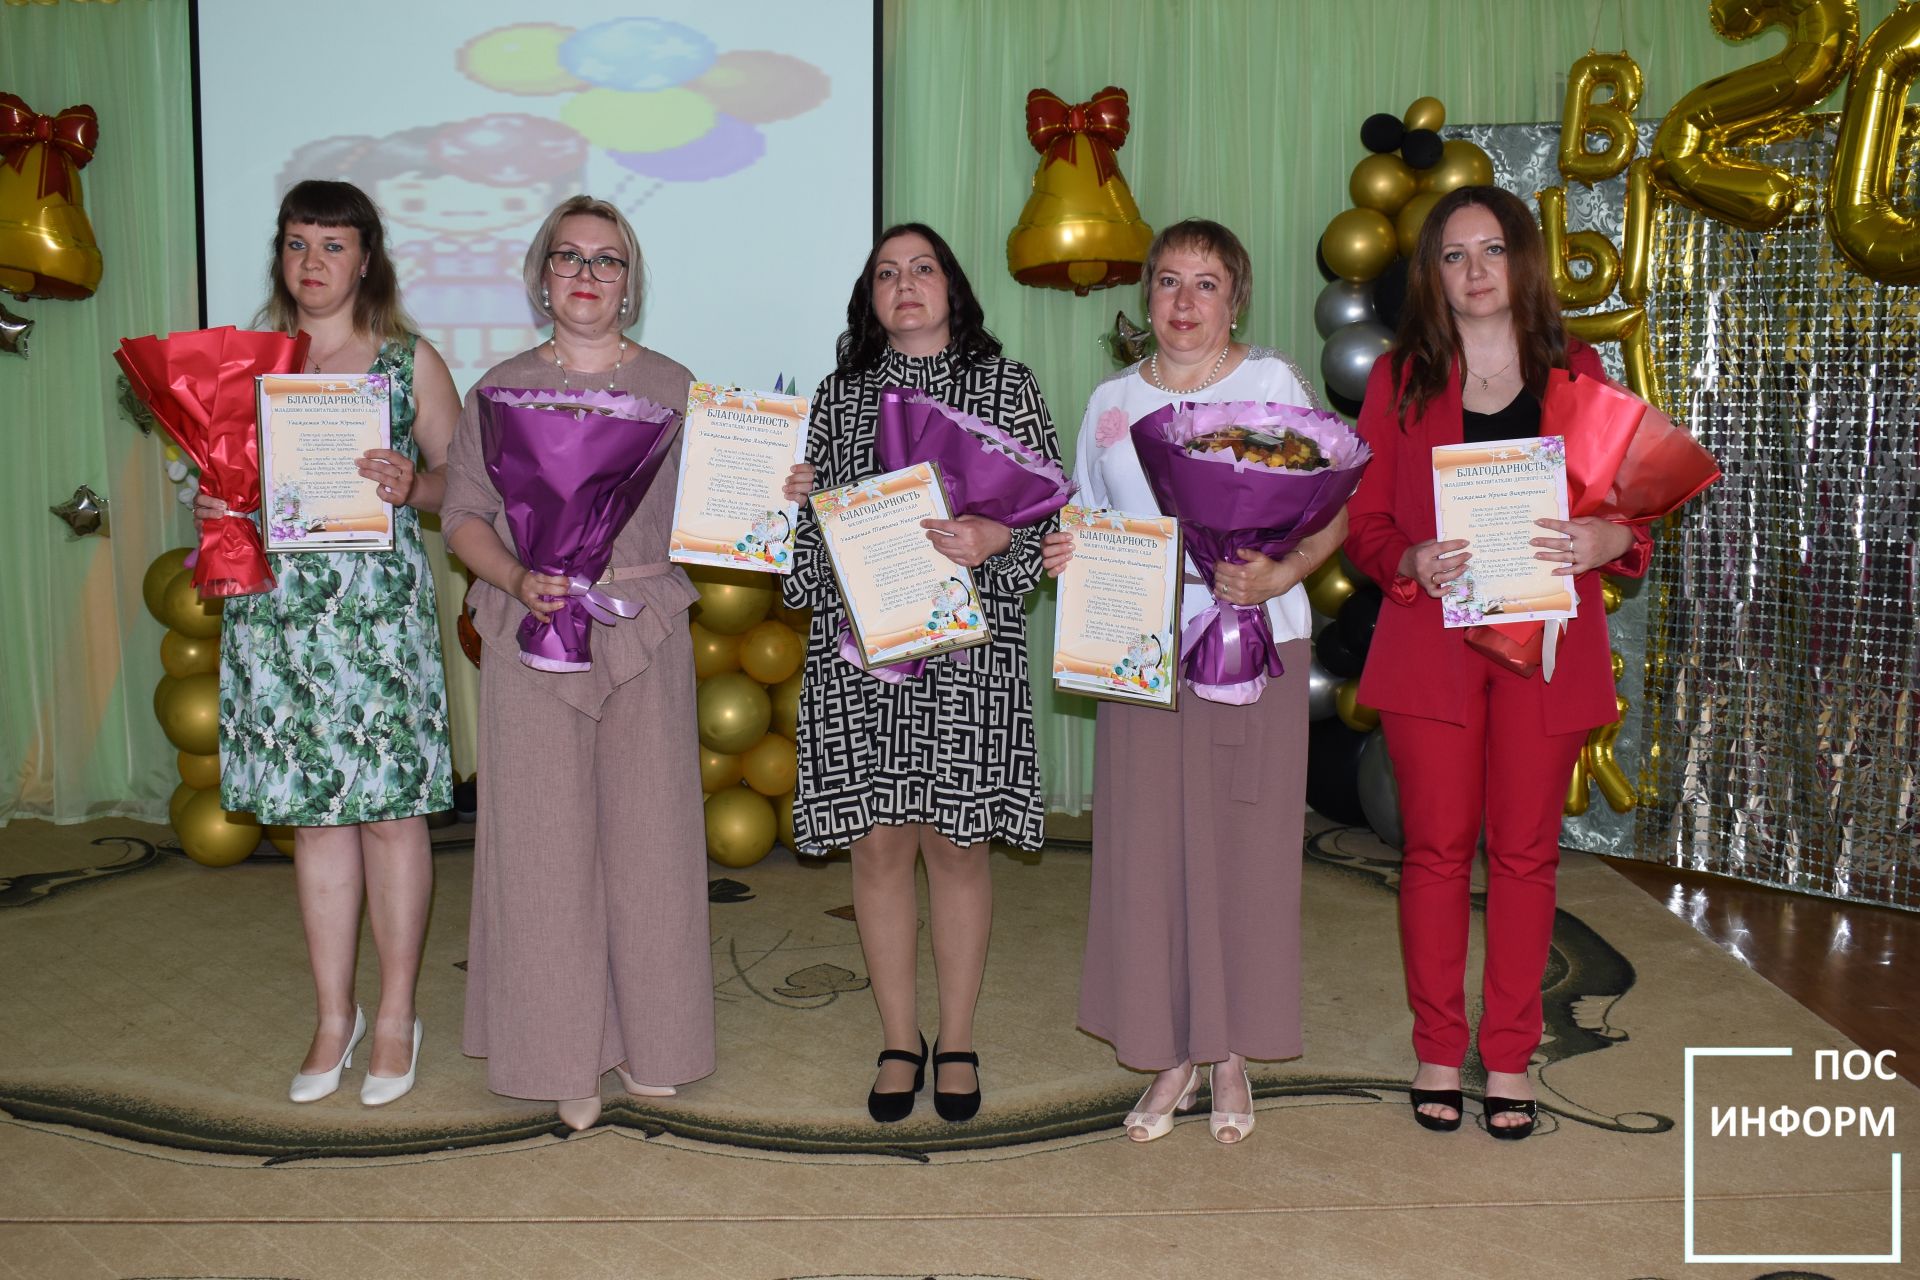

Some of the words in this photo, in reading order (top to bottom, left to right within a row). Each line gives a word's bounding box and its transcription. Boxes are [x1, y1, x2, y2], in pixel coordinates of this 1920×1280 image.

[286, 395, 371, 405] БЛАГОДАРНОСТЬ
[706, 407, 790, 429] БЛАГОДАРНОСТЬ
[1456, 461, 1547, 479] БЛАГОДАРНОСТЬ
[838, 489, 921, 522] БЛАГОДАРНОСТЬ
[1078, 529, 1158, 550] БЛАГОДАРНОСТЬ
